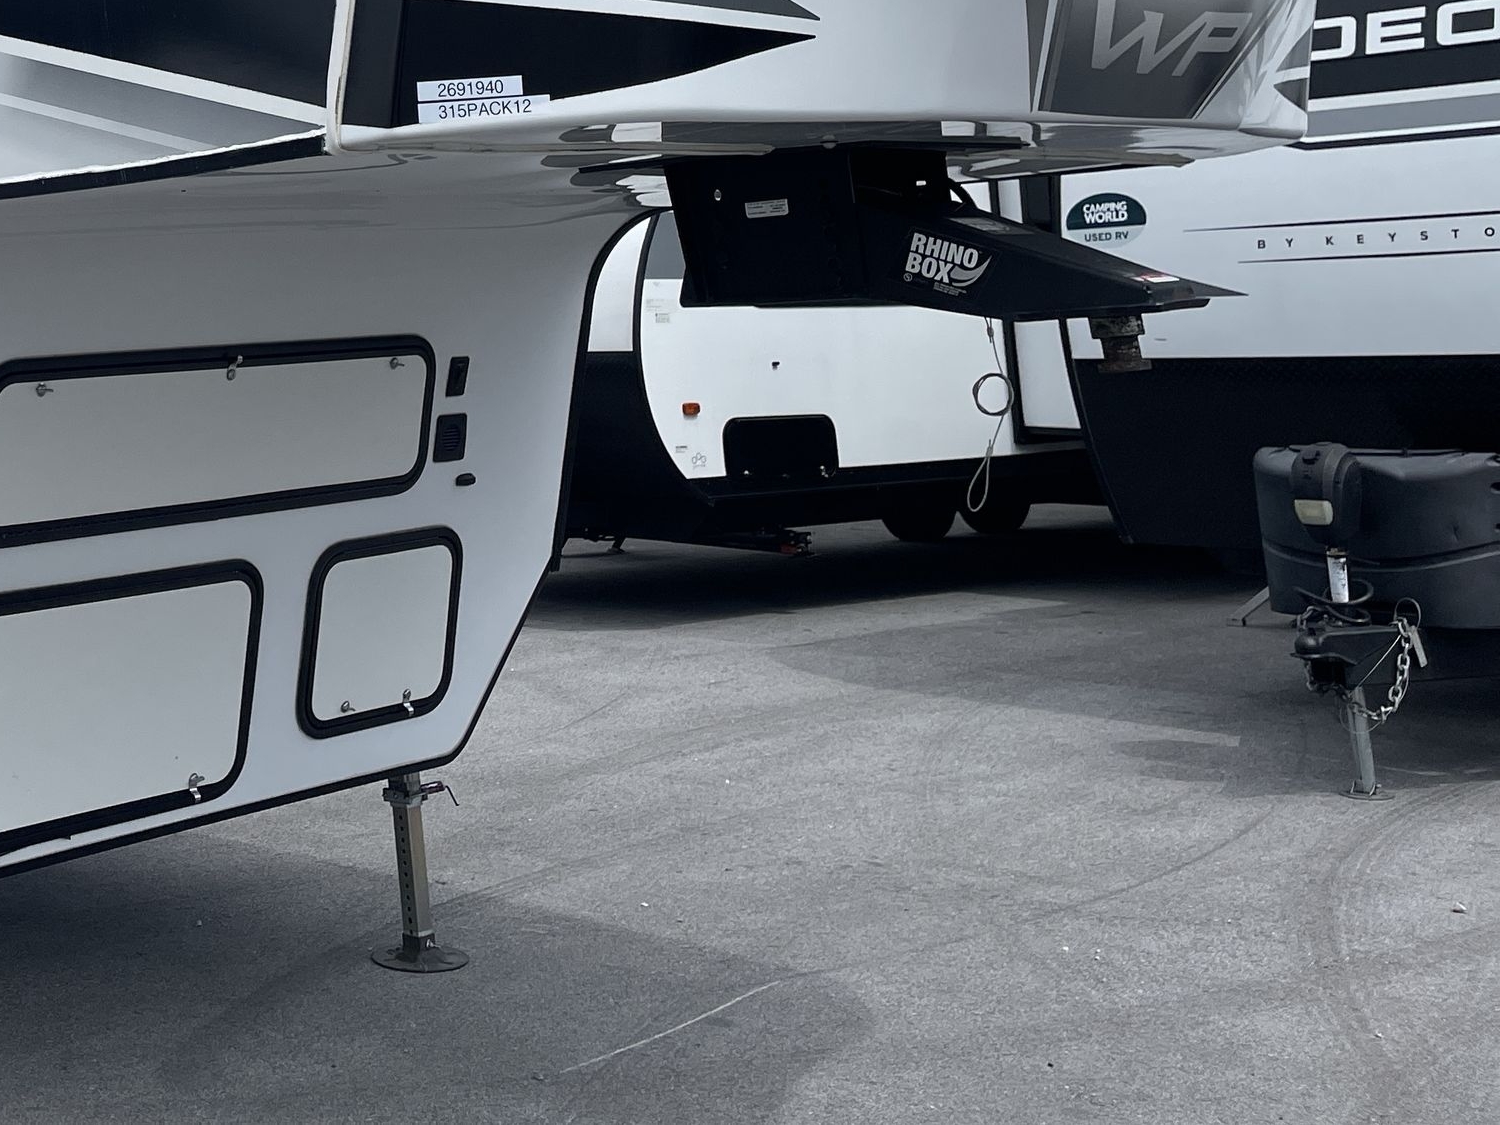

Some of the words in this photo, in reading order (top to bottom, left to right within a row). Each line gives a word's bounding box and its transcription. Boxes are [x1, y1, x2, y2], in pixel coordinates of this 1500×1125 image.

[437, 79, 504, 98] 2691940
[438, 98, 532, 119] 315PACK12
[1083, 201, 1128, 213] CAMPING
[1083, 211, 1128, 224] WORLD
[1084, 231, 1112, 242] USED
[1115, 230, 1129, 240] RV
[1257, 237, 1294, 249] BY
[1325, 226, 1496, 246] KEYSTO
[910, 232, 979, 269] RHINO
[905, 251, 954, 283] BOX
